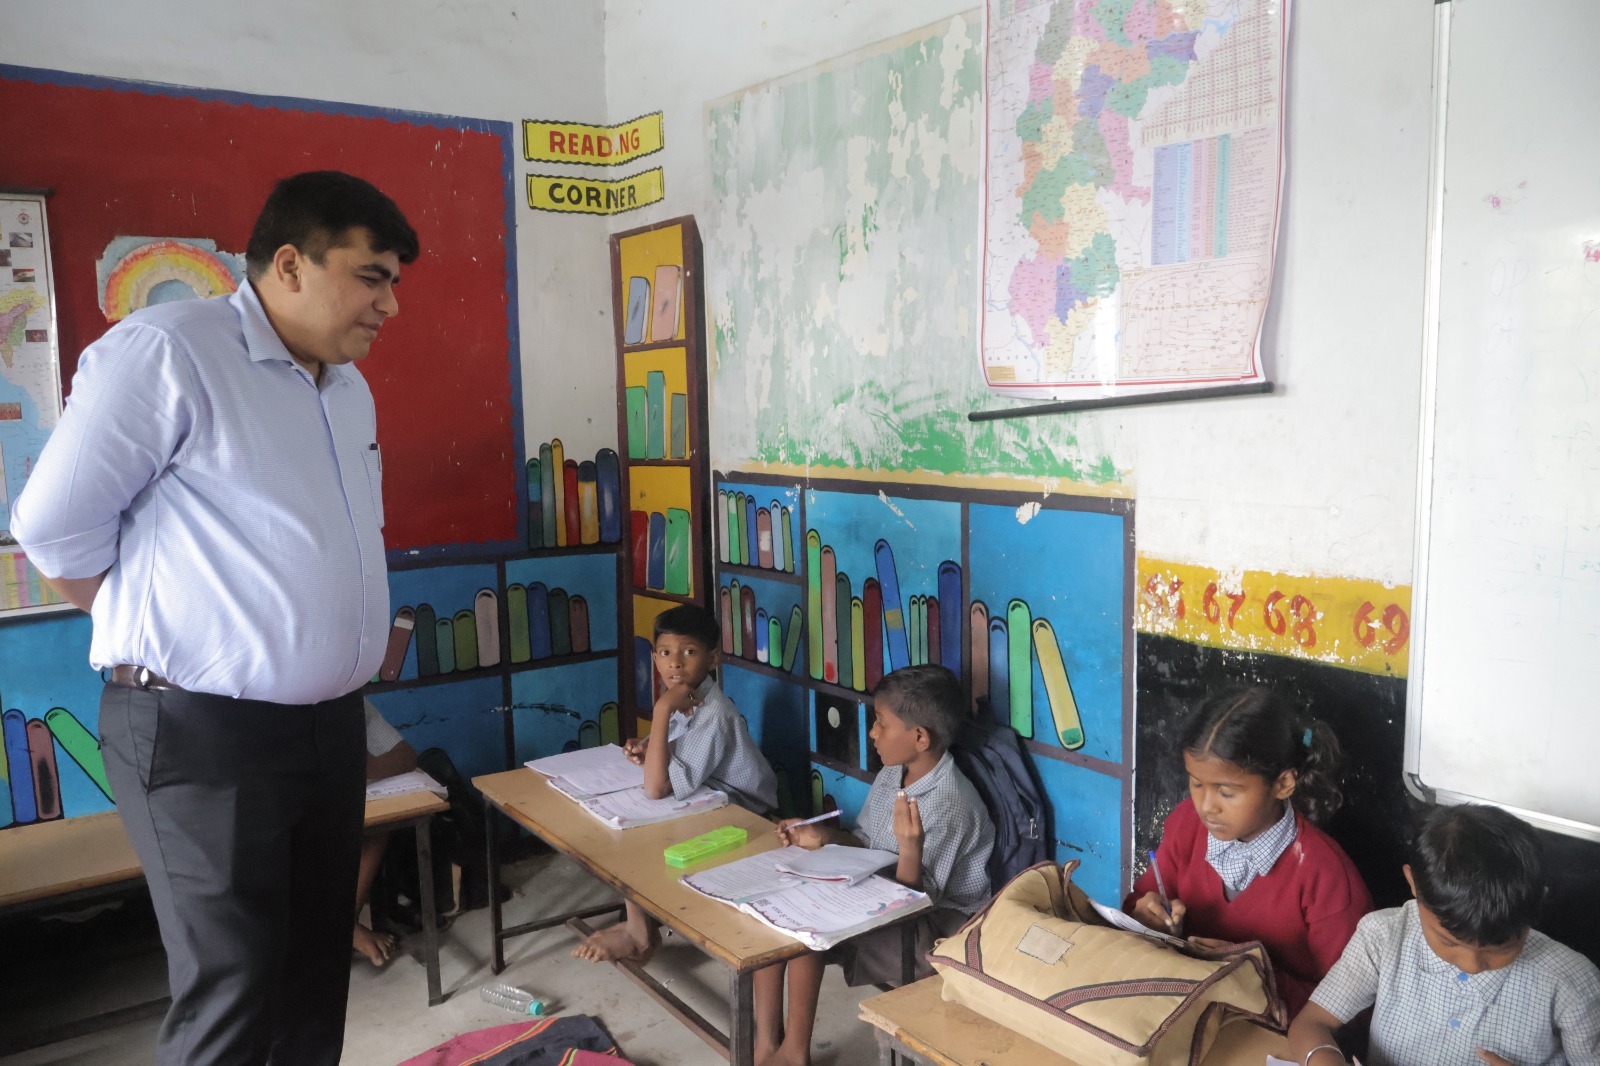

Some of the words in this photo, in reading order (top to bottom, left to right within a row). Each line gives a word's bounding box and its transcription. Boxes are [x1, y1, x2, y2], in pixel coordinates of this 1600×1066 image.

[549, 128, 640, 157] READNG
[548, 182, 637, 209] CORNER
[1203, 582, 1247, 630] 67
[1263, 590, 1317, 647] 68
[1353, 601, 1410, 655] 69
